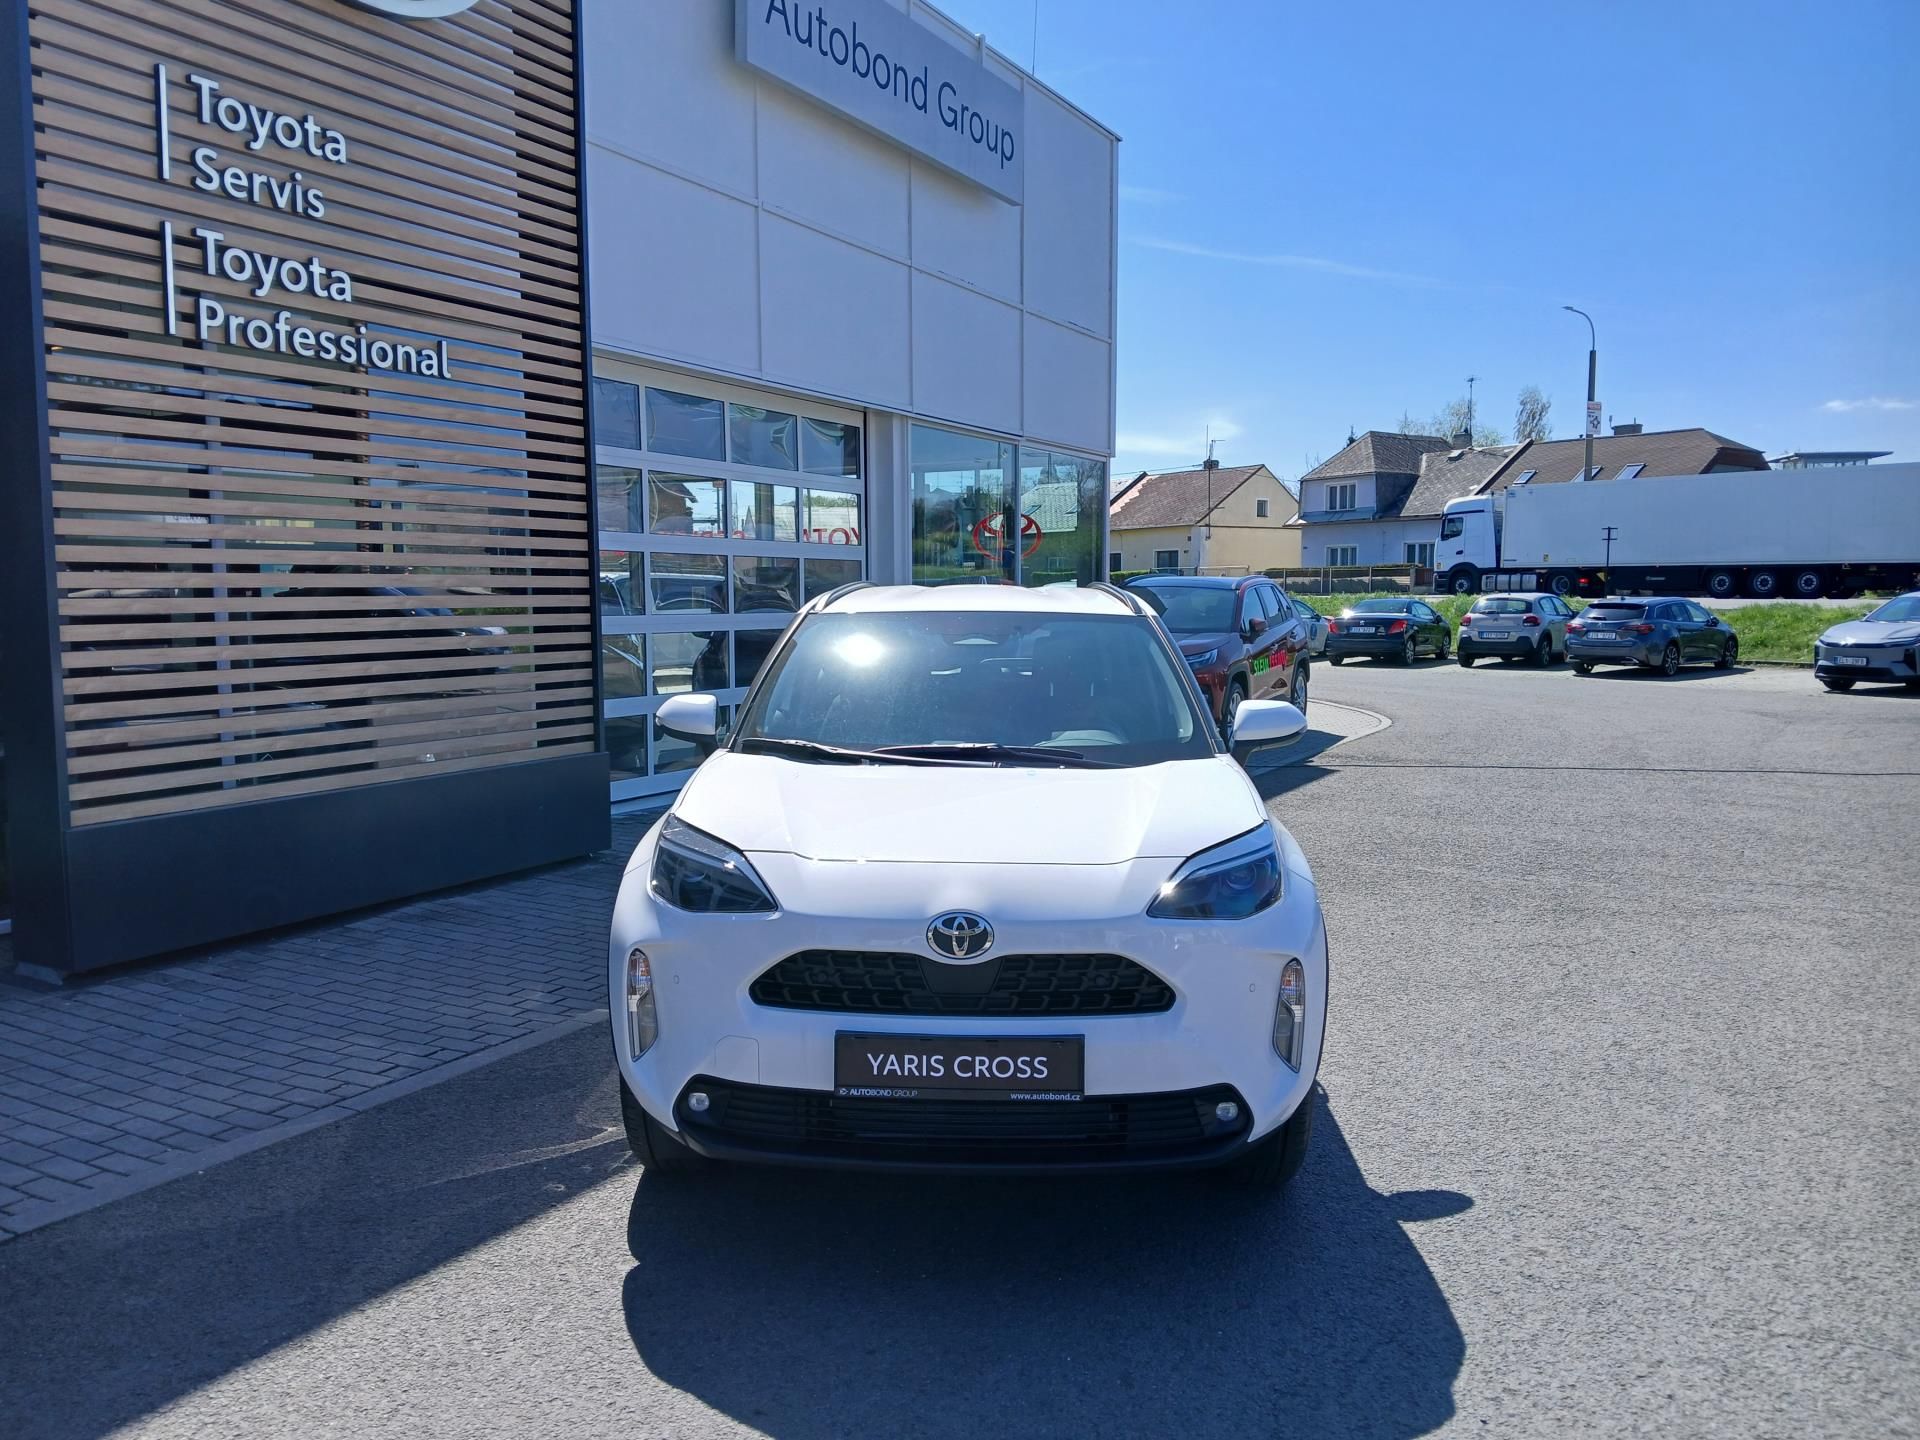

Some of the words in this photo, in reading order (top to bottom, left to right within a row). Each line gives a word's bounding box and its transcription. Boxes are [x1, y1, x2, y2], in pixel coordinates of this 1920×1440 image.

[188, 72, 347, 164] Toyota
[765, 0, 927, 114] Autobond
[938, 82, 1015, 169] Group
[193, 147, 326, 219] Servis
[194, 227, 353, 303] Toyota
[199, 298, 452, 380] Professional
[849, 1088, 892, 1097] AUTOBOND
[893, 1089, 918, 1097] GROUP
[867, 1053, 945, 1077] YARIS
[953, 1055, 1049, 1079] CROSS
[1010, 1092, 1081, 1101] www.autobond.cz
